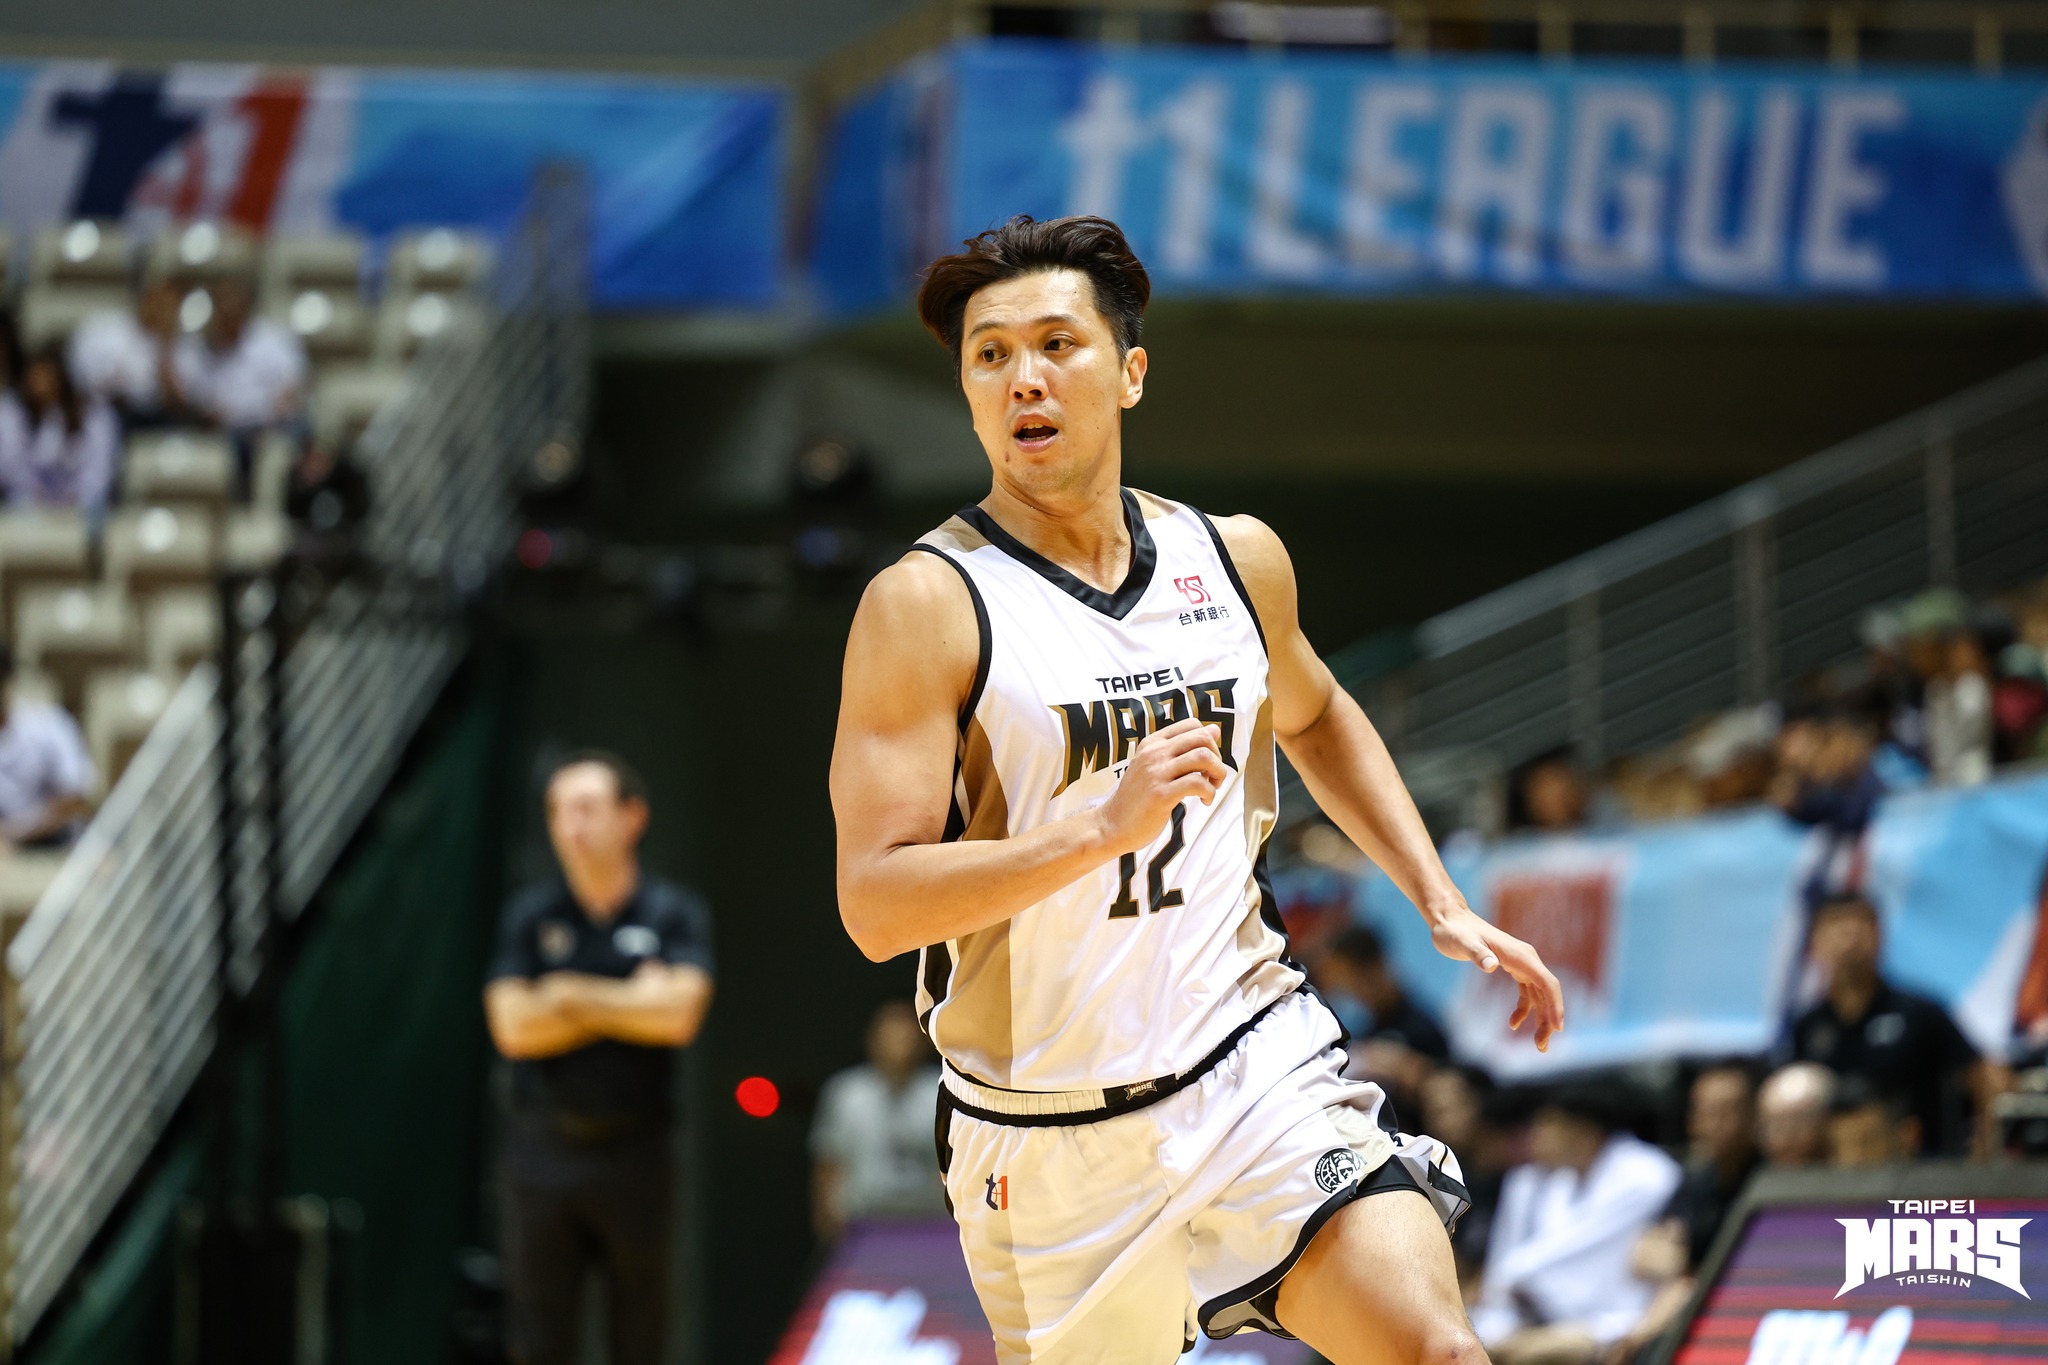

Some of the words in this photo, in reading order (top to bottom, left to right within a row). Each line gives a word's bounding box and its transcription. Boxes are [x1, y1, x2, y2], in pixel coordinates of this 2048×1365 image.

[1245, 80, 1909, 284] LEAGUE
[1178, 605, 1230, 626] 台新銀行
[1095, 666, 1184, 694] TAIPEI
[1107, 801, 1186, 920] 12
